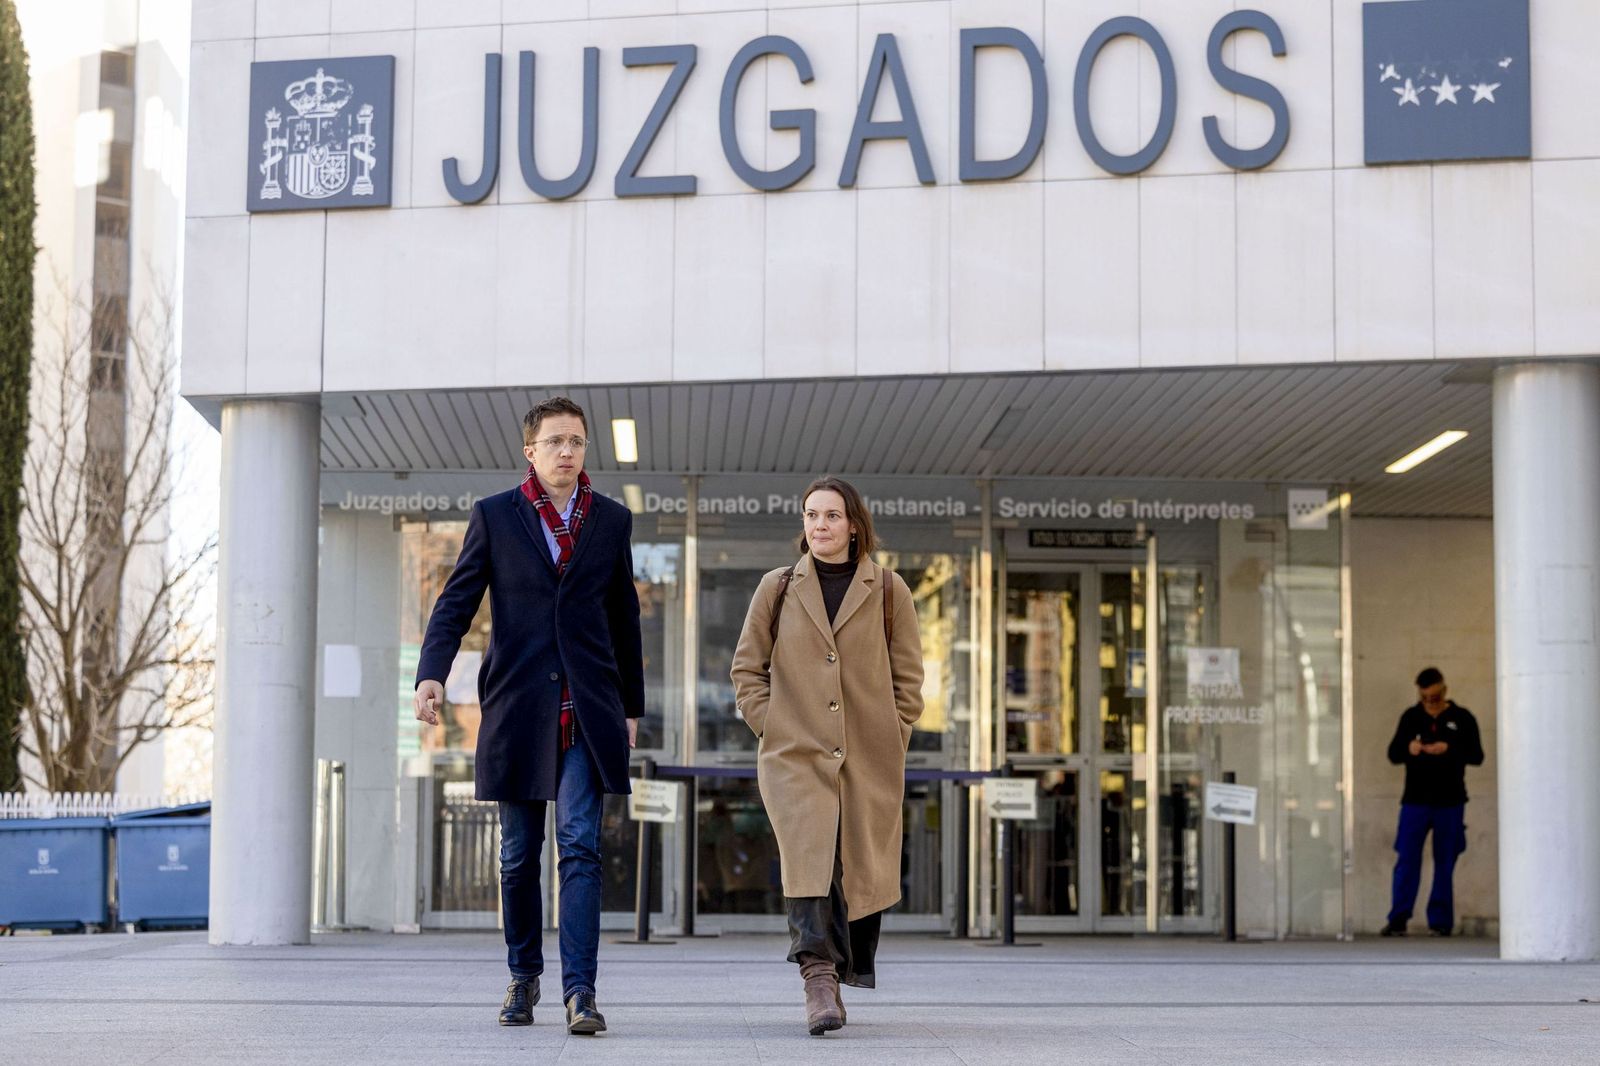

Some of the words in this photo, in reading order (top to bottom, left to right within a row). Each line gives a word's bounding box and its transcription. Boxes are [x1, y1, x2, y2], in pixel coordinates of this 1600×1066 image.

[442, 9, 1291, 205] JUZGADOS
[339, 491, 450, 515] Juzgados
[866, 496, 966, 516] Instancia
[999, 497, 1092, 518] Servicio
[1097, 498, 1126, 519] de
[1132, 498, 1255, 523] Intérpretes
[1166, 704, 1265, 724] PROFESIONALES
